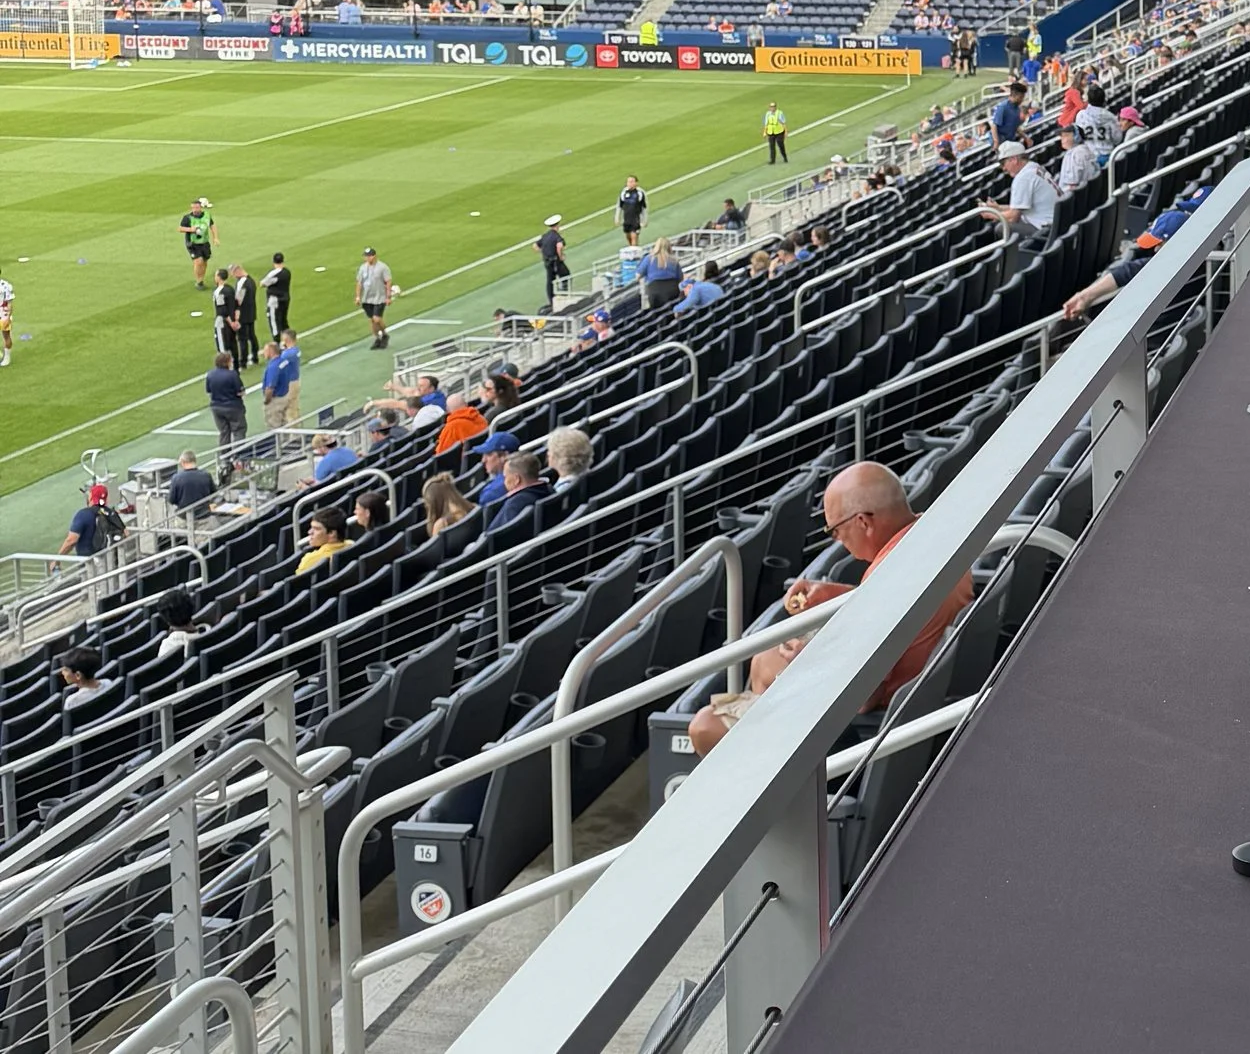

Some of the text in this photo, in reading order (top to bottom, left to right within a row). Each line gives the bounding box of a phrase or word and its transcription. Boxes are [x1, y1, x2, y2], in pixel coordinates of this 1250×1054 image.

[205, 38, 268, 51] DISCOUNT
[437, 43, 485, 64] TQL
[518, 45, 565, 66] TQL
[621, 50, 672, 64] TOYOTA
[703, 52, 754, 65] TOYOTA
[770, 50, 909, 69] Continental Tire
[1084, 126, 1106, 141] 23
[677, 738, 690, 750] 17
[420, 847, 432, 859] 16
